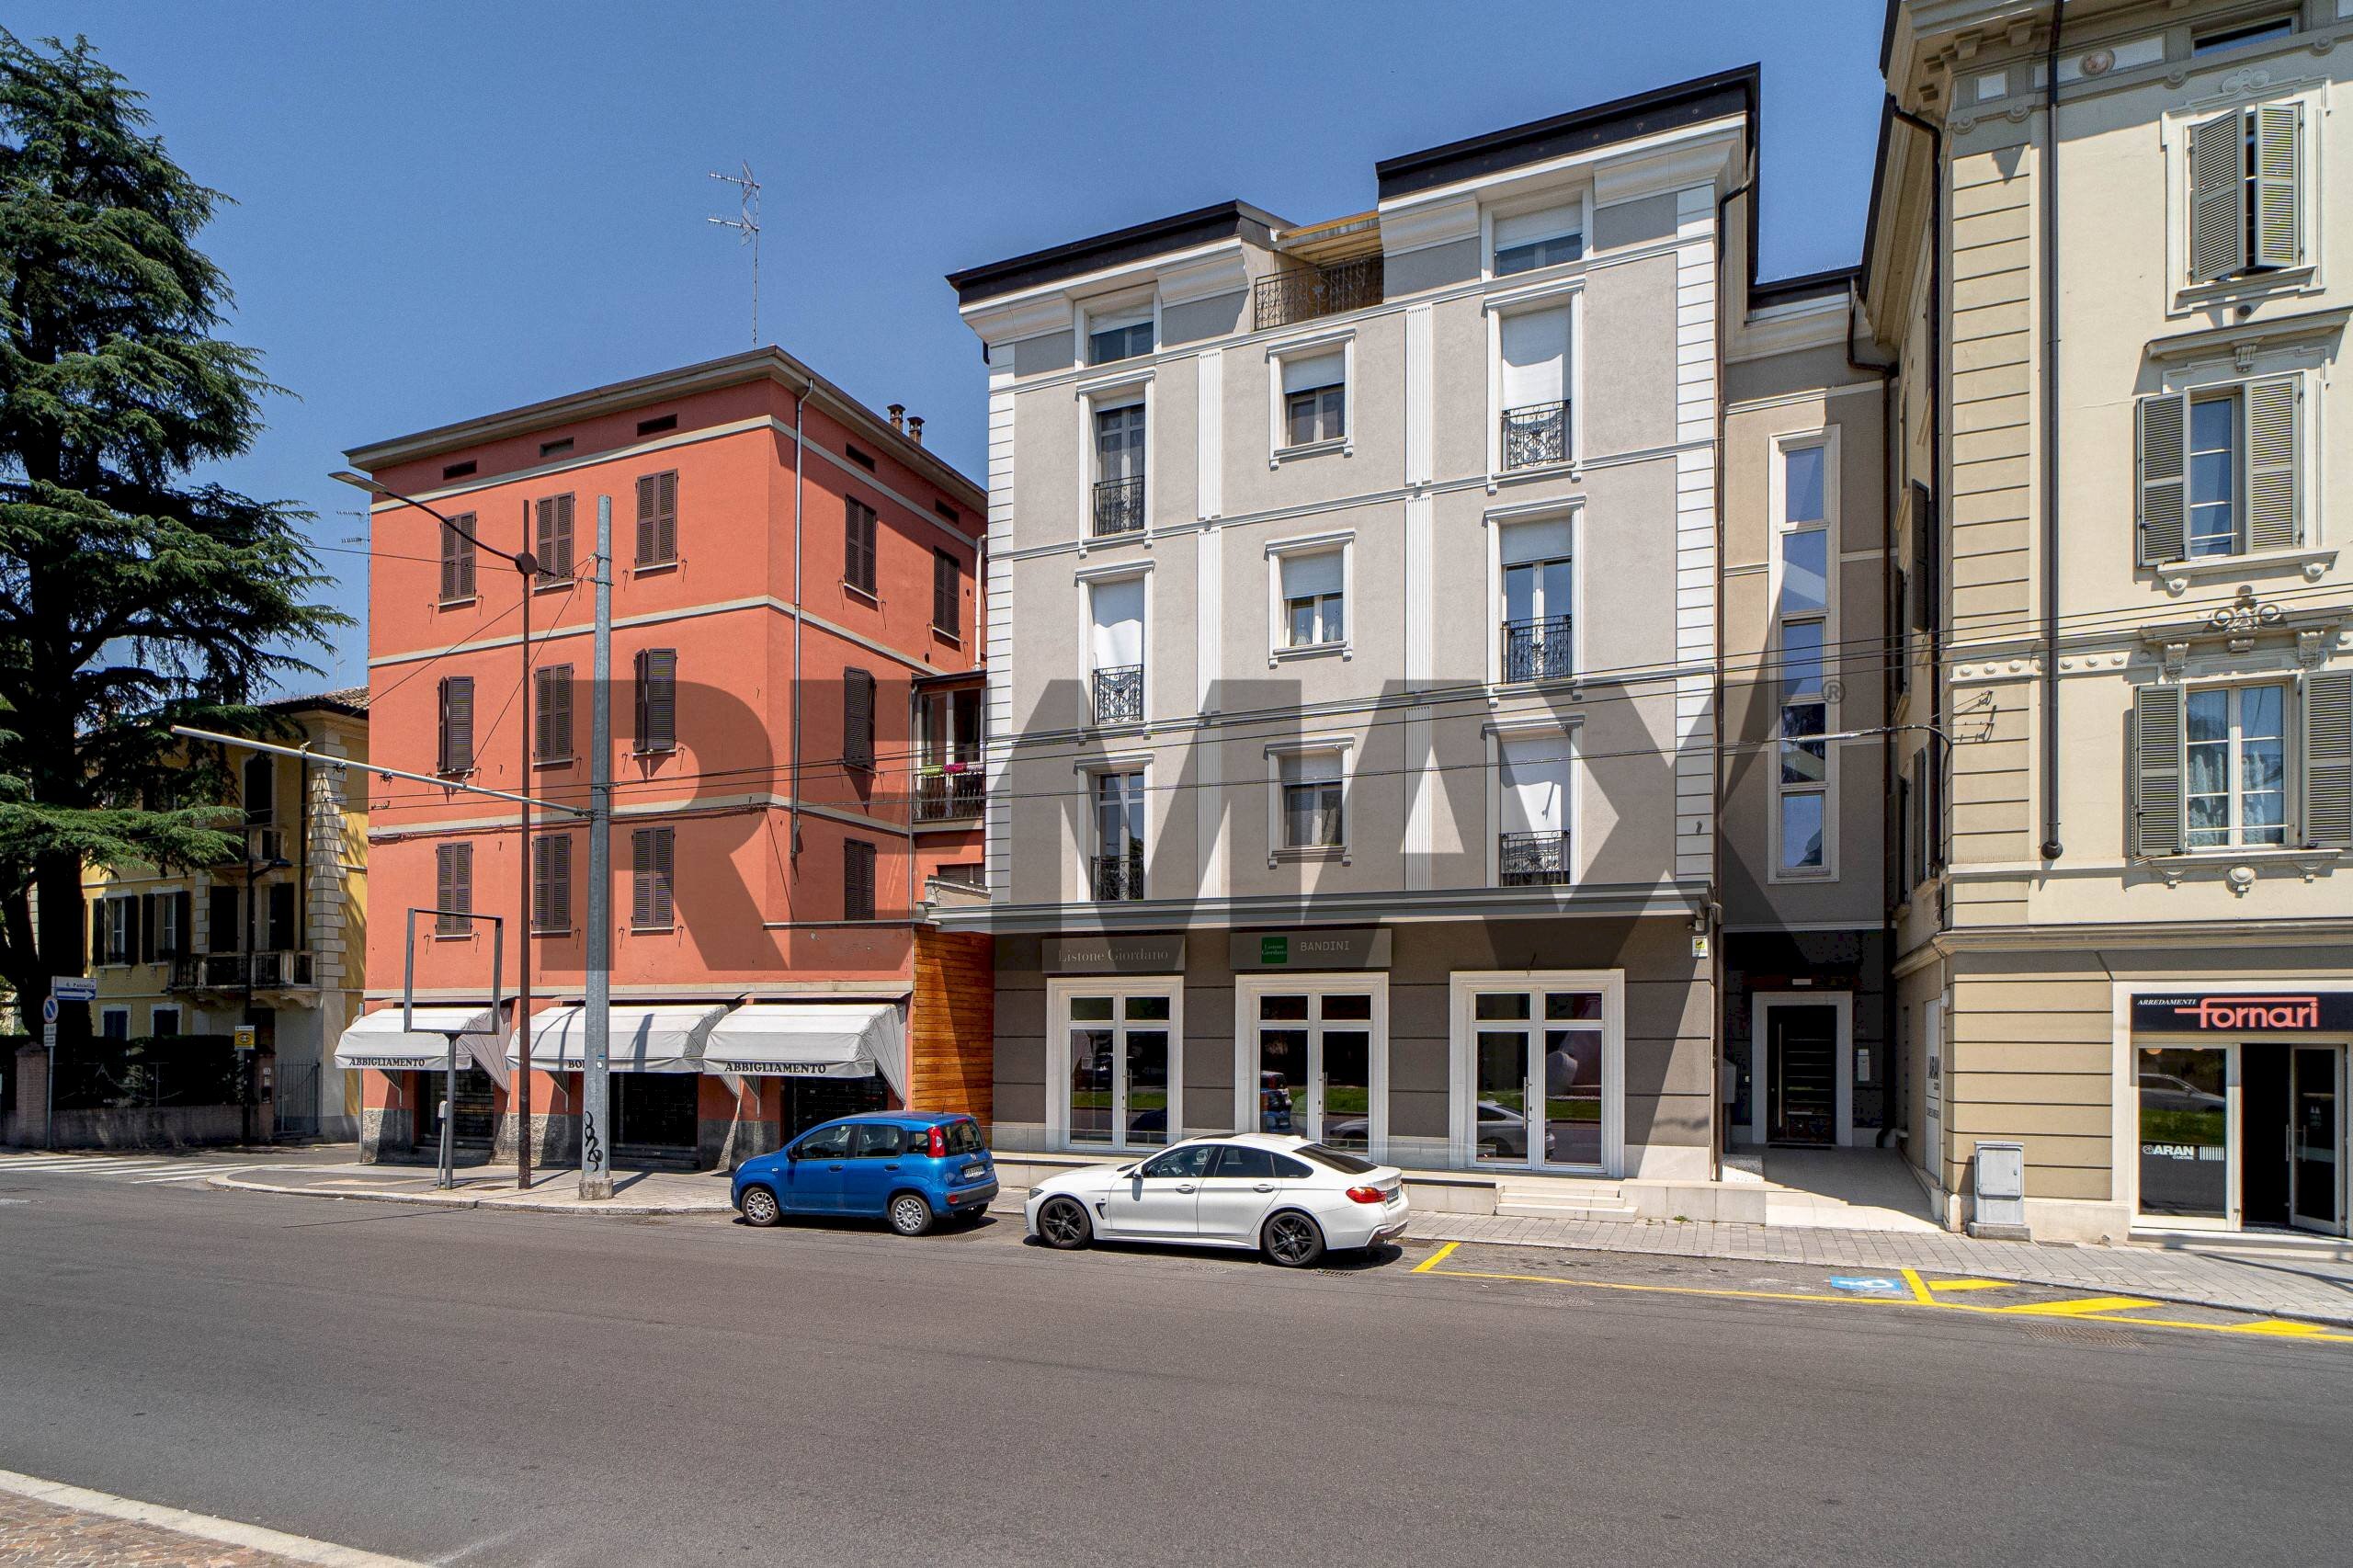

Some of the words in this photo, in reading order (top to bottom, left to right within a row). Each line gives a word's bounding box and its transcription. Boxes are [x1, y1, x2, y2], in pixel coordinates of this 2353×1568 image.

[1301, 940, 1350, 952] BANDINI
[1059, 949, 1104, 962] Listone
[1108, 948, 1168, 961] Giordano
[349, 1058, 426, 1067] ABBIGLIAMENTO
[724, 1062, 827, 1074] ABBIGLIAMENTO
[2153, 1144, 2195, 1156] ARAN
